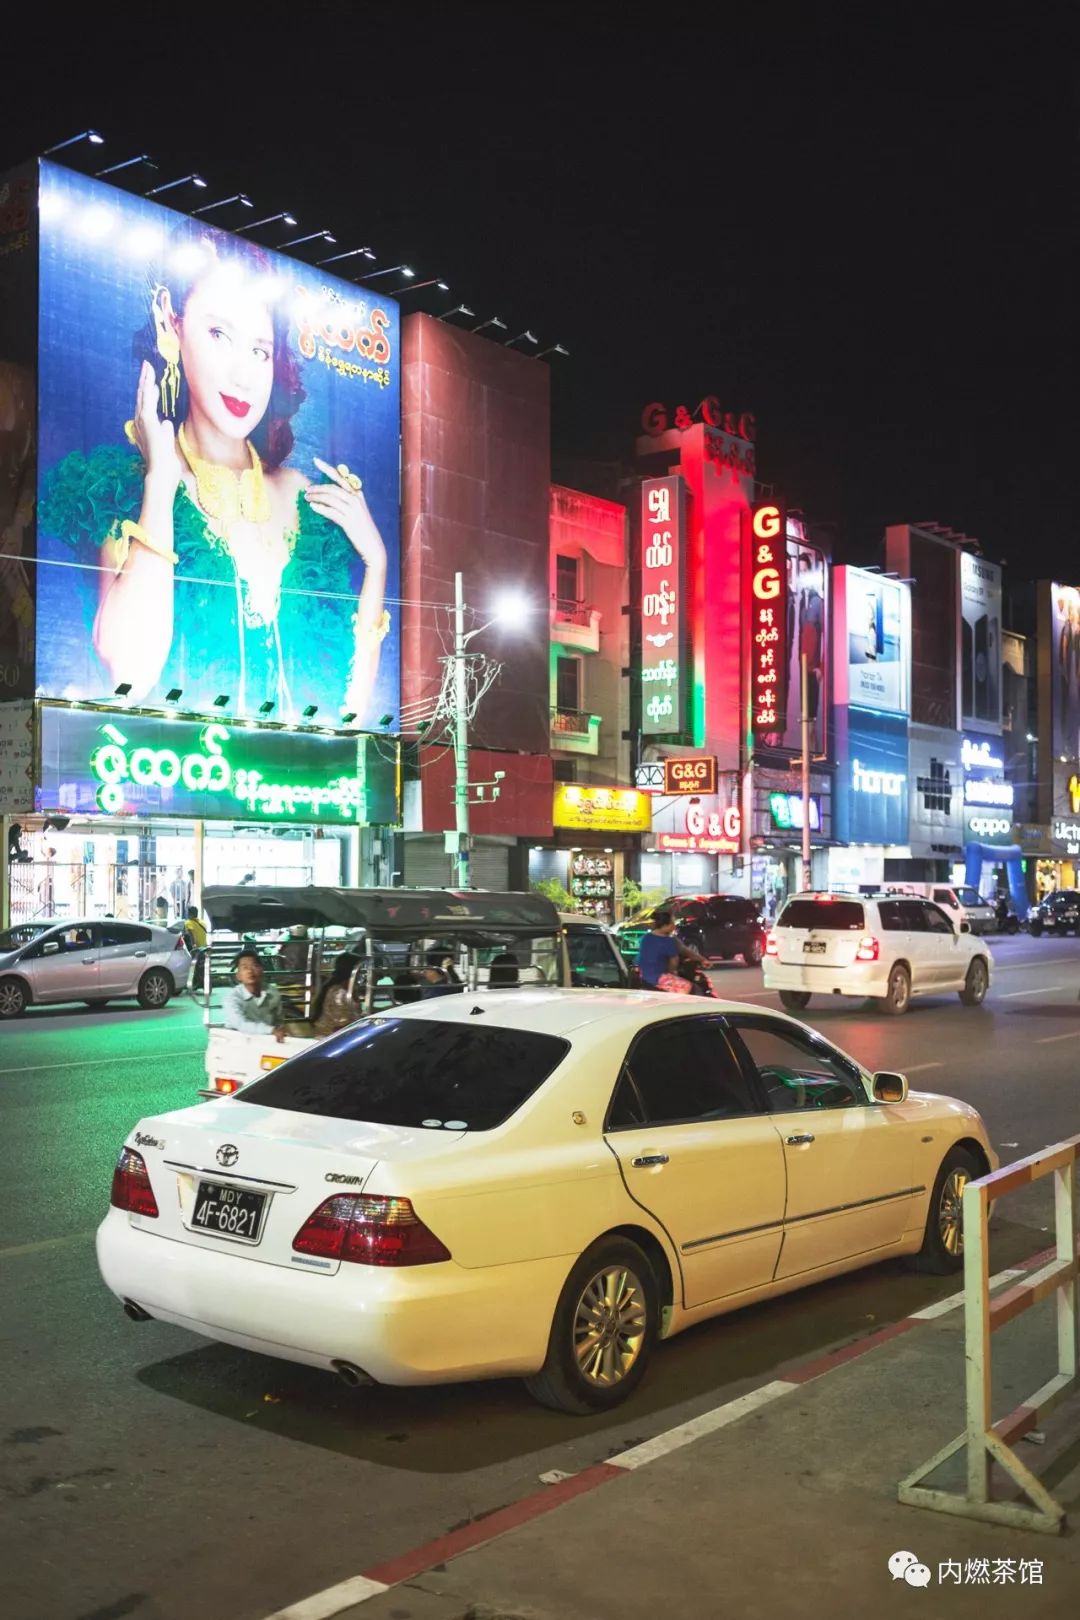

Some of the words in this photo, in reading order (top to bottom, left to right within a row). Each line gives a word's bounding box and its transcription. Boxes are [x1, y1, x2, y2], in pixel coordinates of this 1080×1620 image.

[671, 762, 708, 779] G&G
[853, 759, 906, 797] honor
[970, 818, 1010, 837] oppo
[324, 1172, 364, 1186] CROWN
[219, 1188, 243, 1205] MDY
[196, 1199, 257, 1236] 4F-6821
